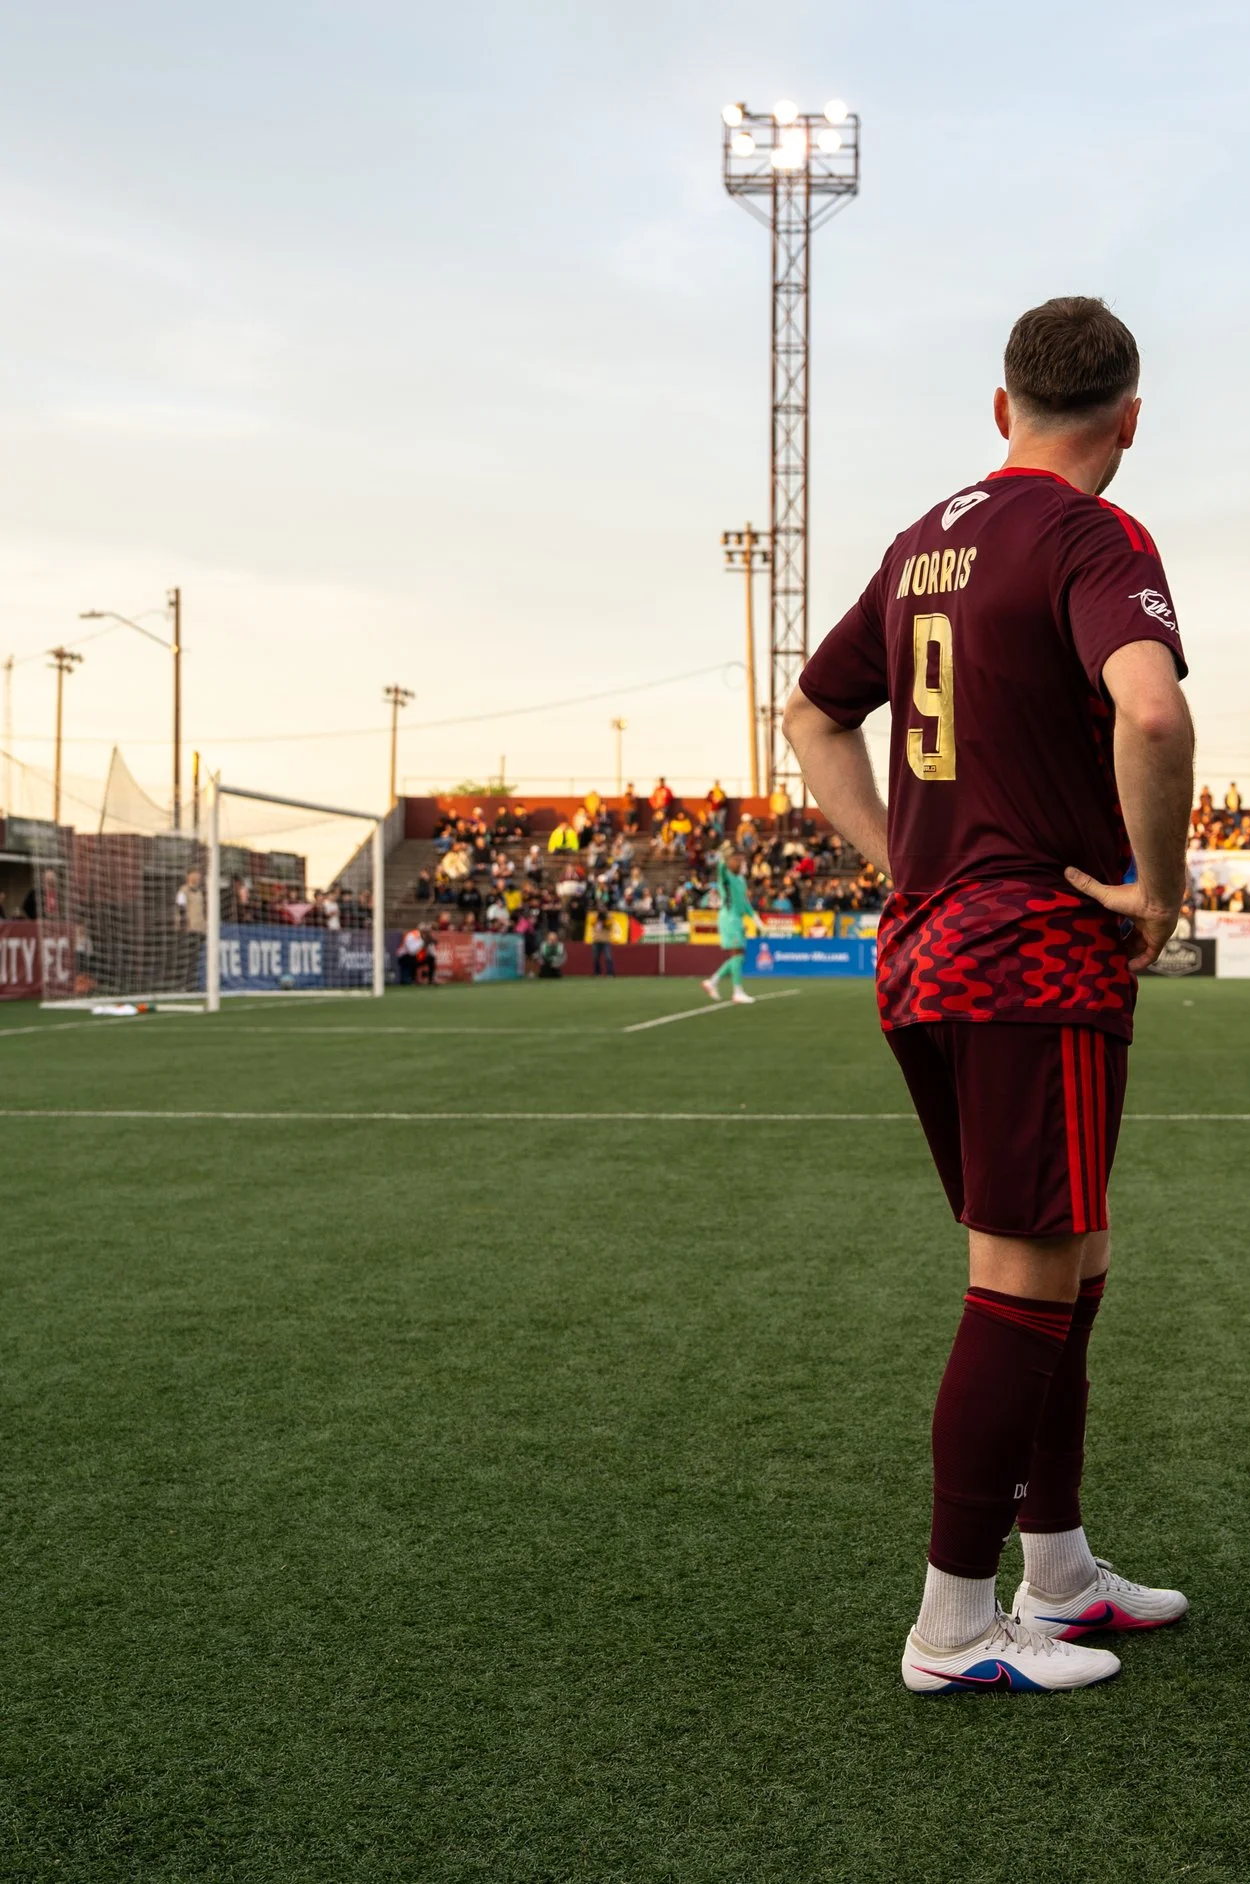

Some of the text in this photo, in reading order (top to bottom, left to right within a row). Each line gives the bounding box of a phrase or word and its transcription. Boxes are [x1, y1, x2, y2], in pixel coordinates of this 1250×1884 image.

[896, 547, 977, 599] MORRIS
[907, 612, 956, 780] 9
[42, 936, 70, 982] FC
[220, 940, 242, 976] TE
[249, 940, 282, 976] DTE
[289, 941, 322, 976] DTE
